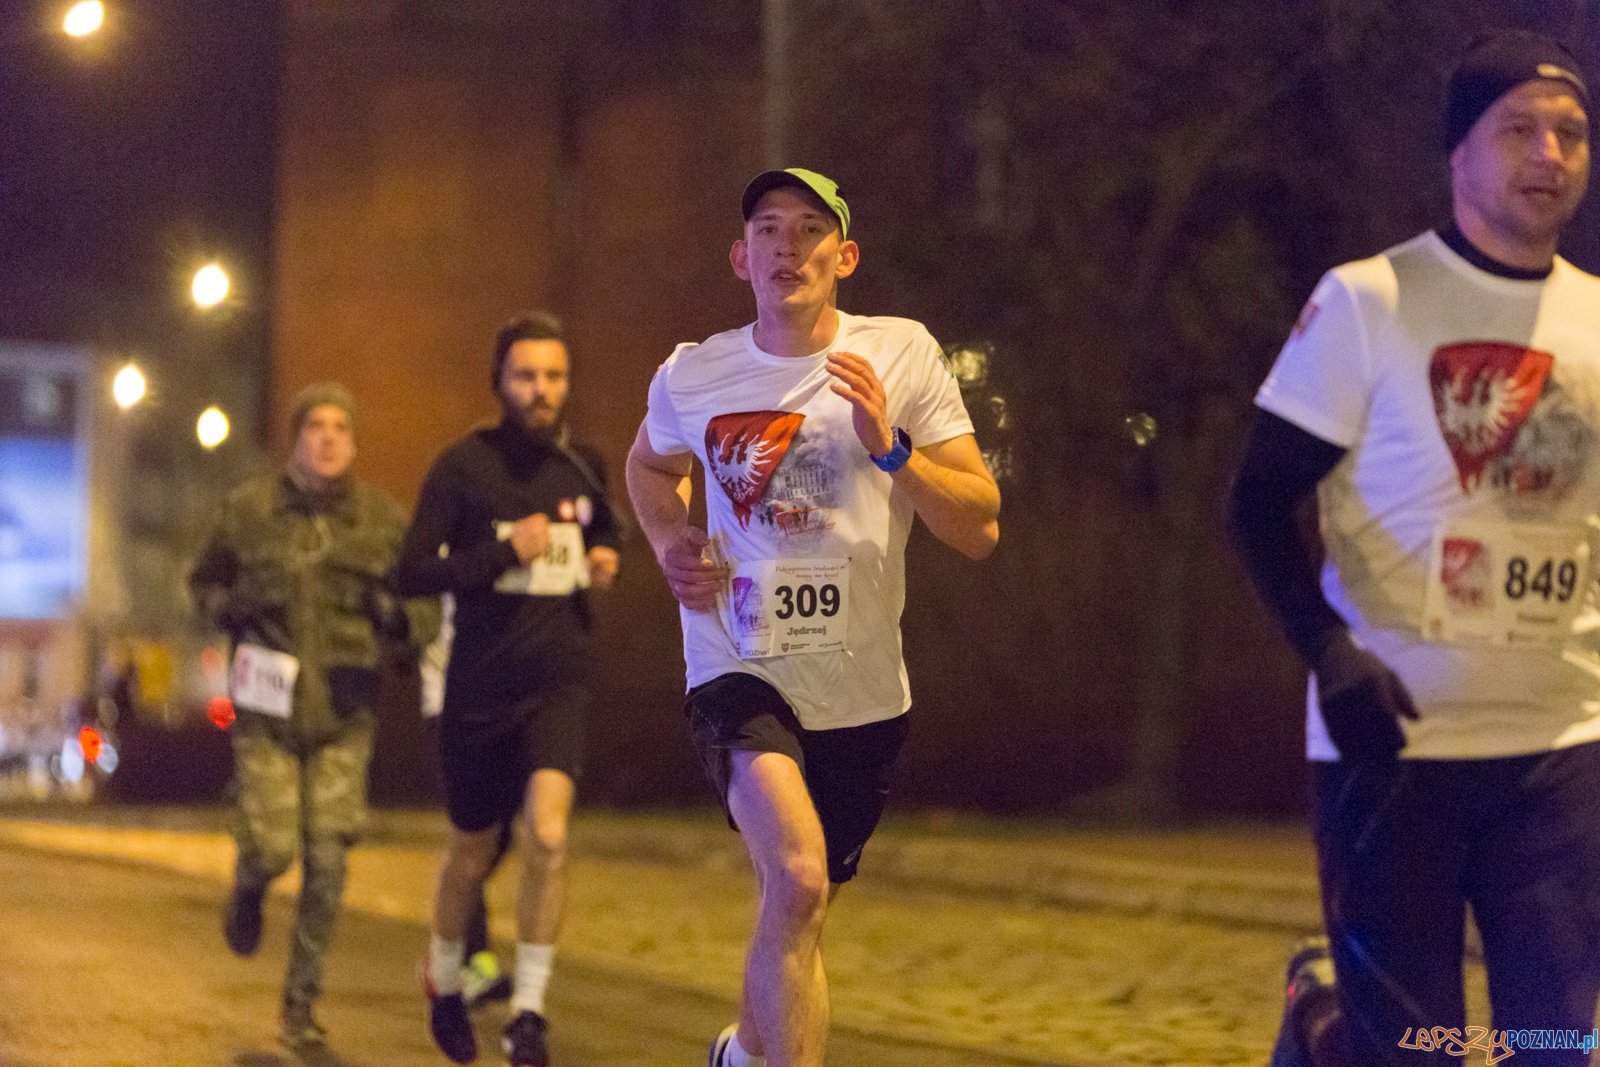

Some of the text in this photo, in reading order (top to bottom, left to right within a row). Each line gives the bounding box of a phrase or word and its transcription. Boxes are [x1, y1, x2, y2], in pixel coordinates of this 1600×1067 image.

[1504, 557, 1578, 602] 849
[774, 584, 840, 620] 309
[786, 625, 827, 637] Jędrzej
